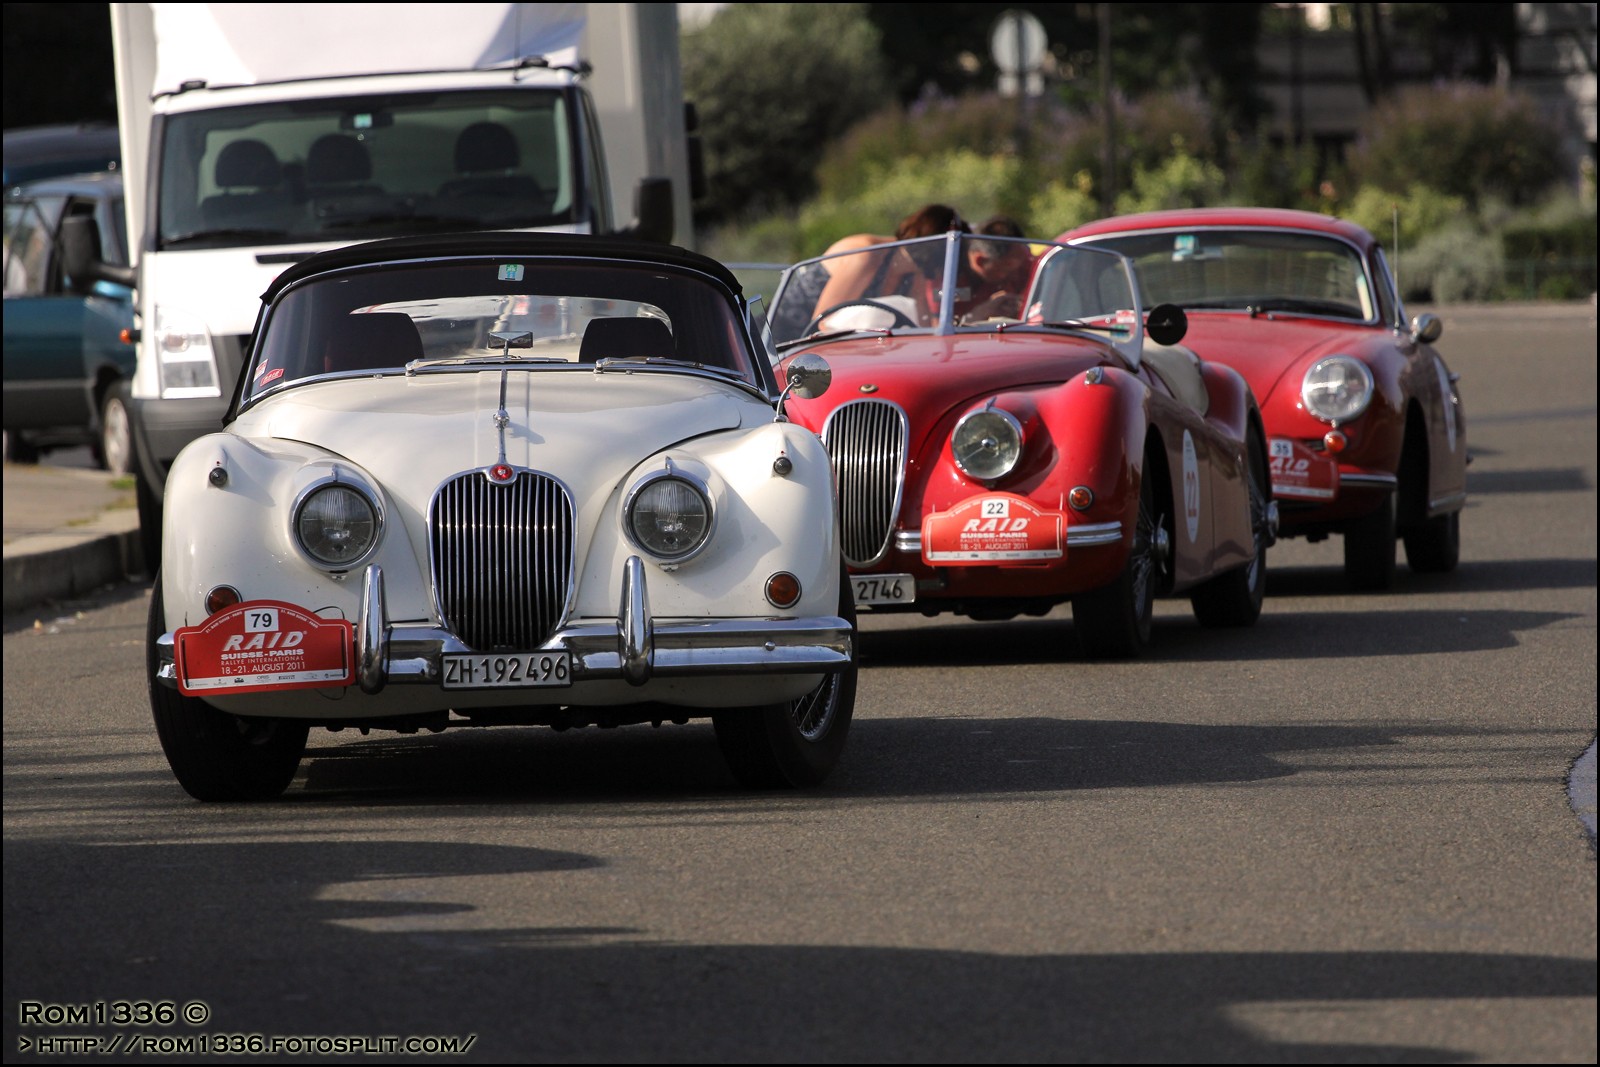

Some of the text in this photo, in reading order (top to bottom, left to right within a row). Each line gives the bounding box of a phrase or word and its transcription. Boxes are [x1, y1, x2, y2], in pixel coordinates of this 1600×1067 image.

[987, 502, 1004, 515] 22
[857, 579, 903, 600] 2746
[250, 613, 272, 628] 79
[222, 631, 304, 652] RAID
[220, 648, 304, 661] SUISSE-PARIS
[247, 655, 304, 664] INTERNATIONAL
[221, 661, 306, 675] 18.-21. AUGUST 2011
